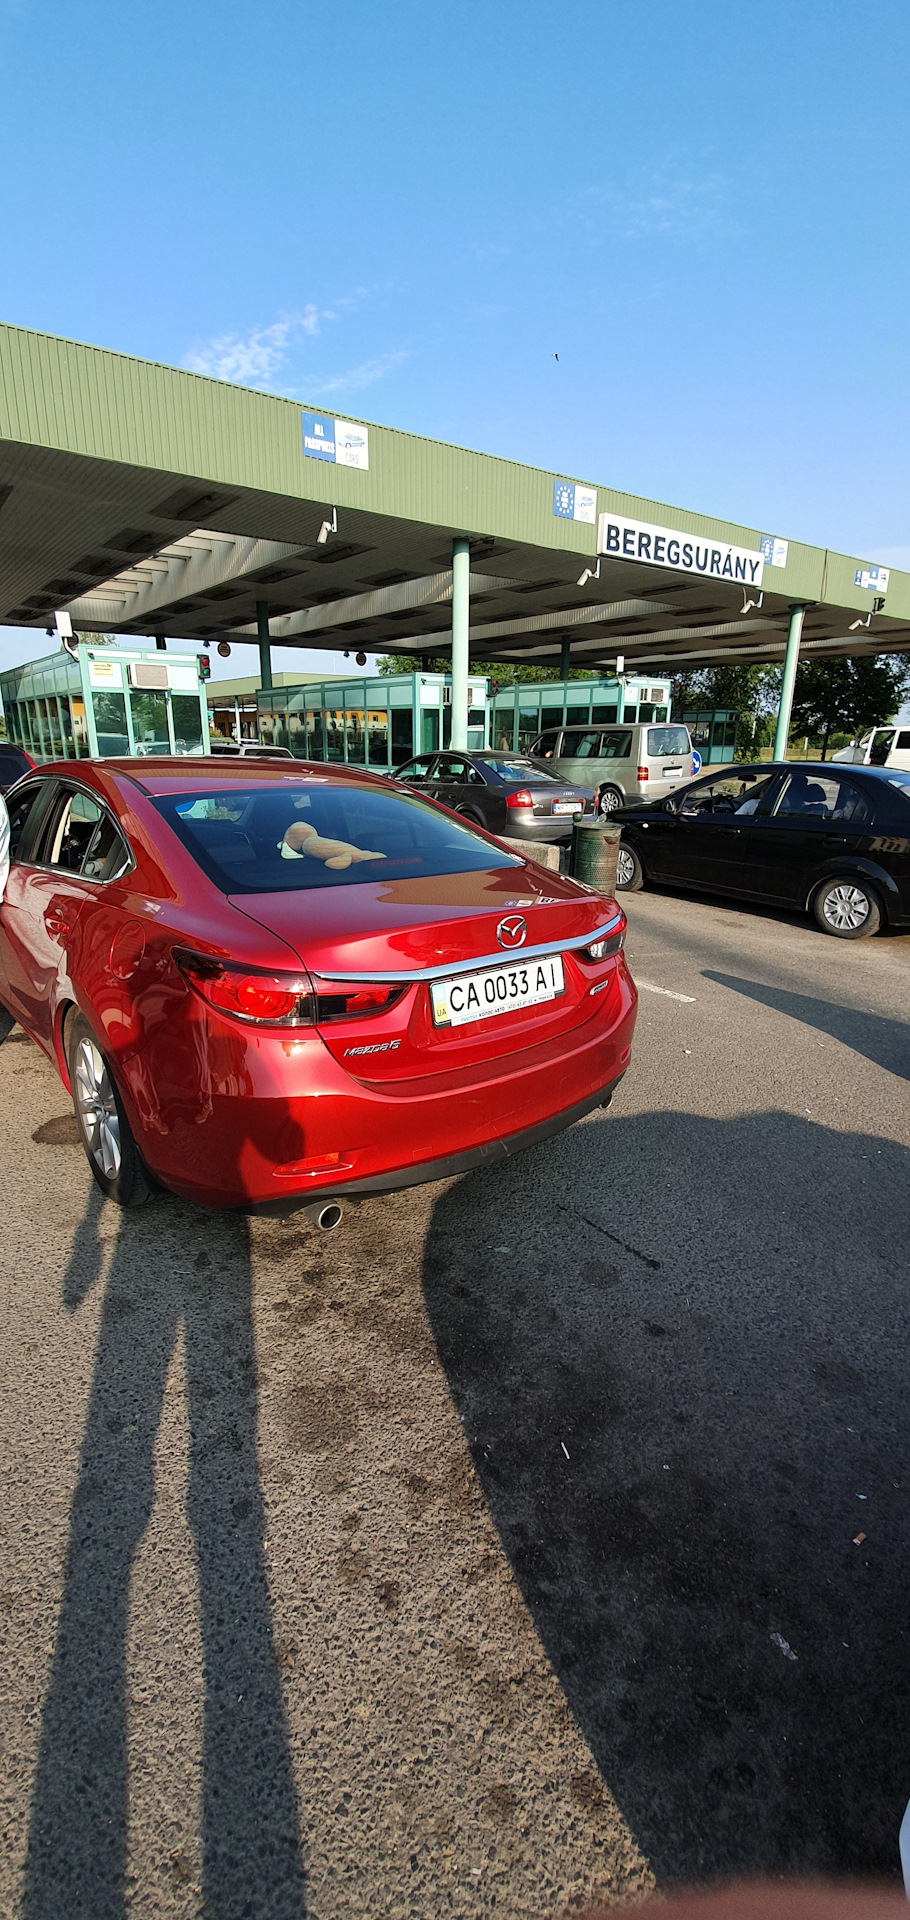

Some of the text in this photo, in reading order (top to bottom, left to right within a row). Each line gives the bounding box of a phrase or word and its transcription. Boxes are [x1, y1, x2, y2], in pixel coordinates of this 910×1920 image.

[606, 524, 760, 582] BEREGSURÁNY
[484, 970, 529, 1003] 0033
[436, 1008, 447, 1017] UA
